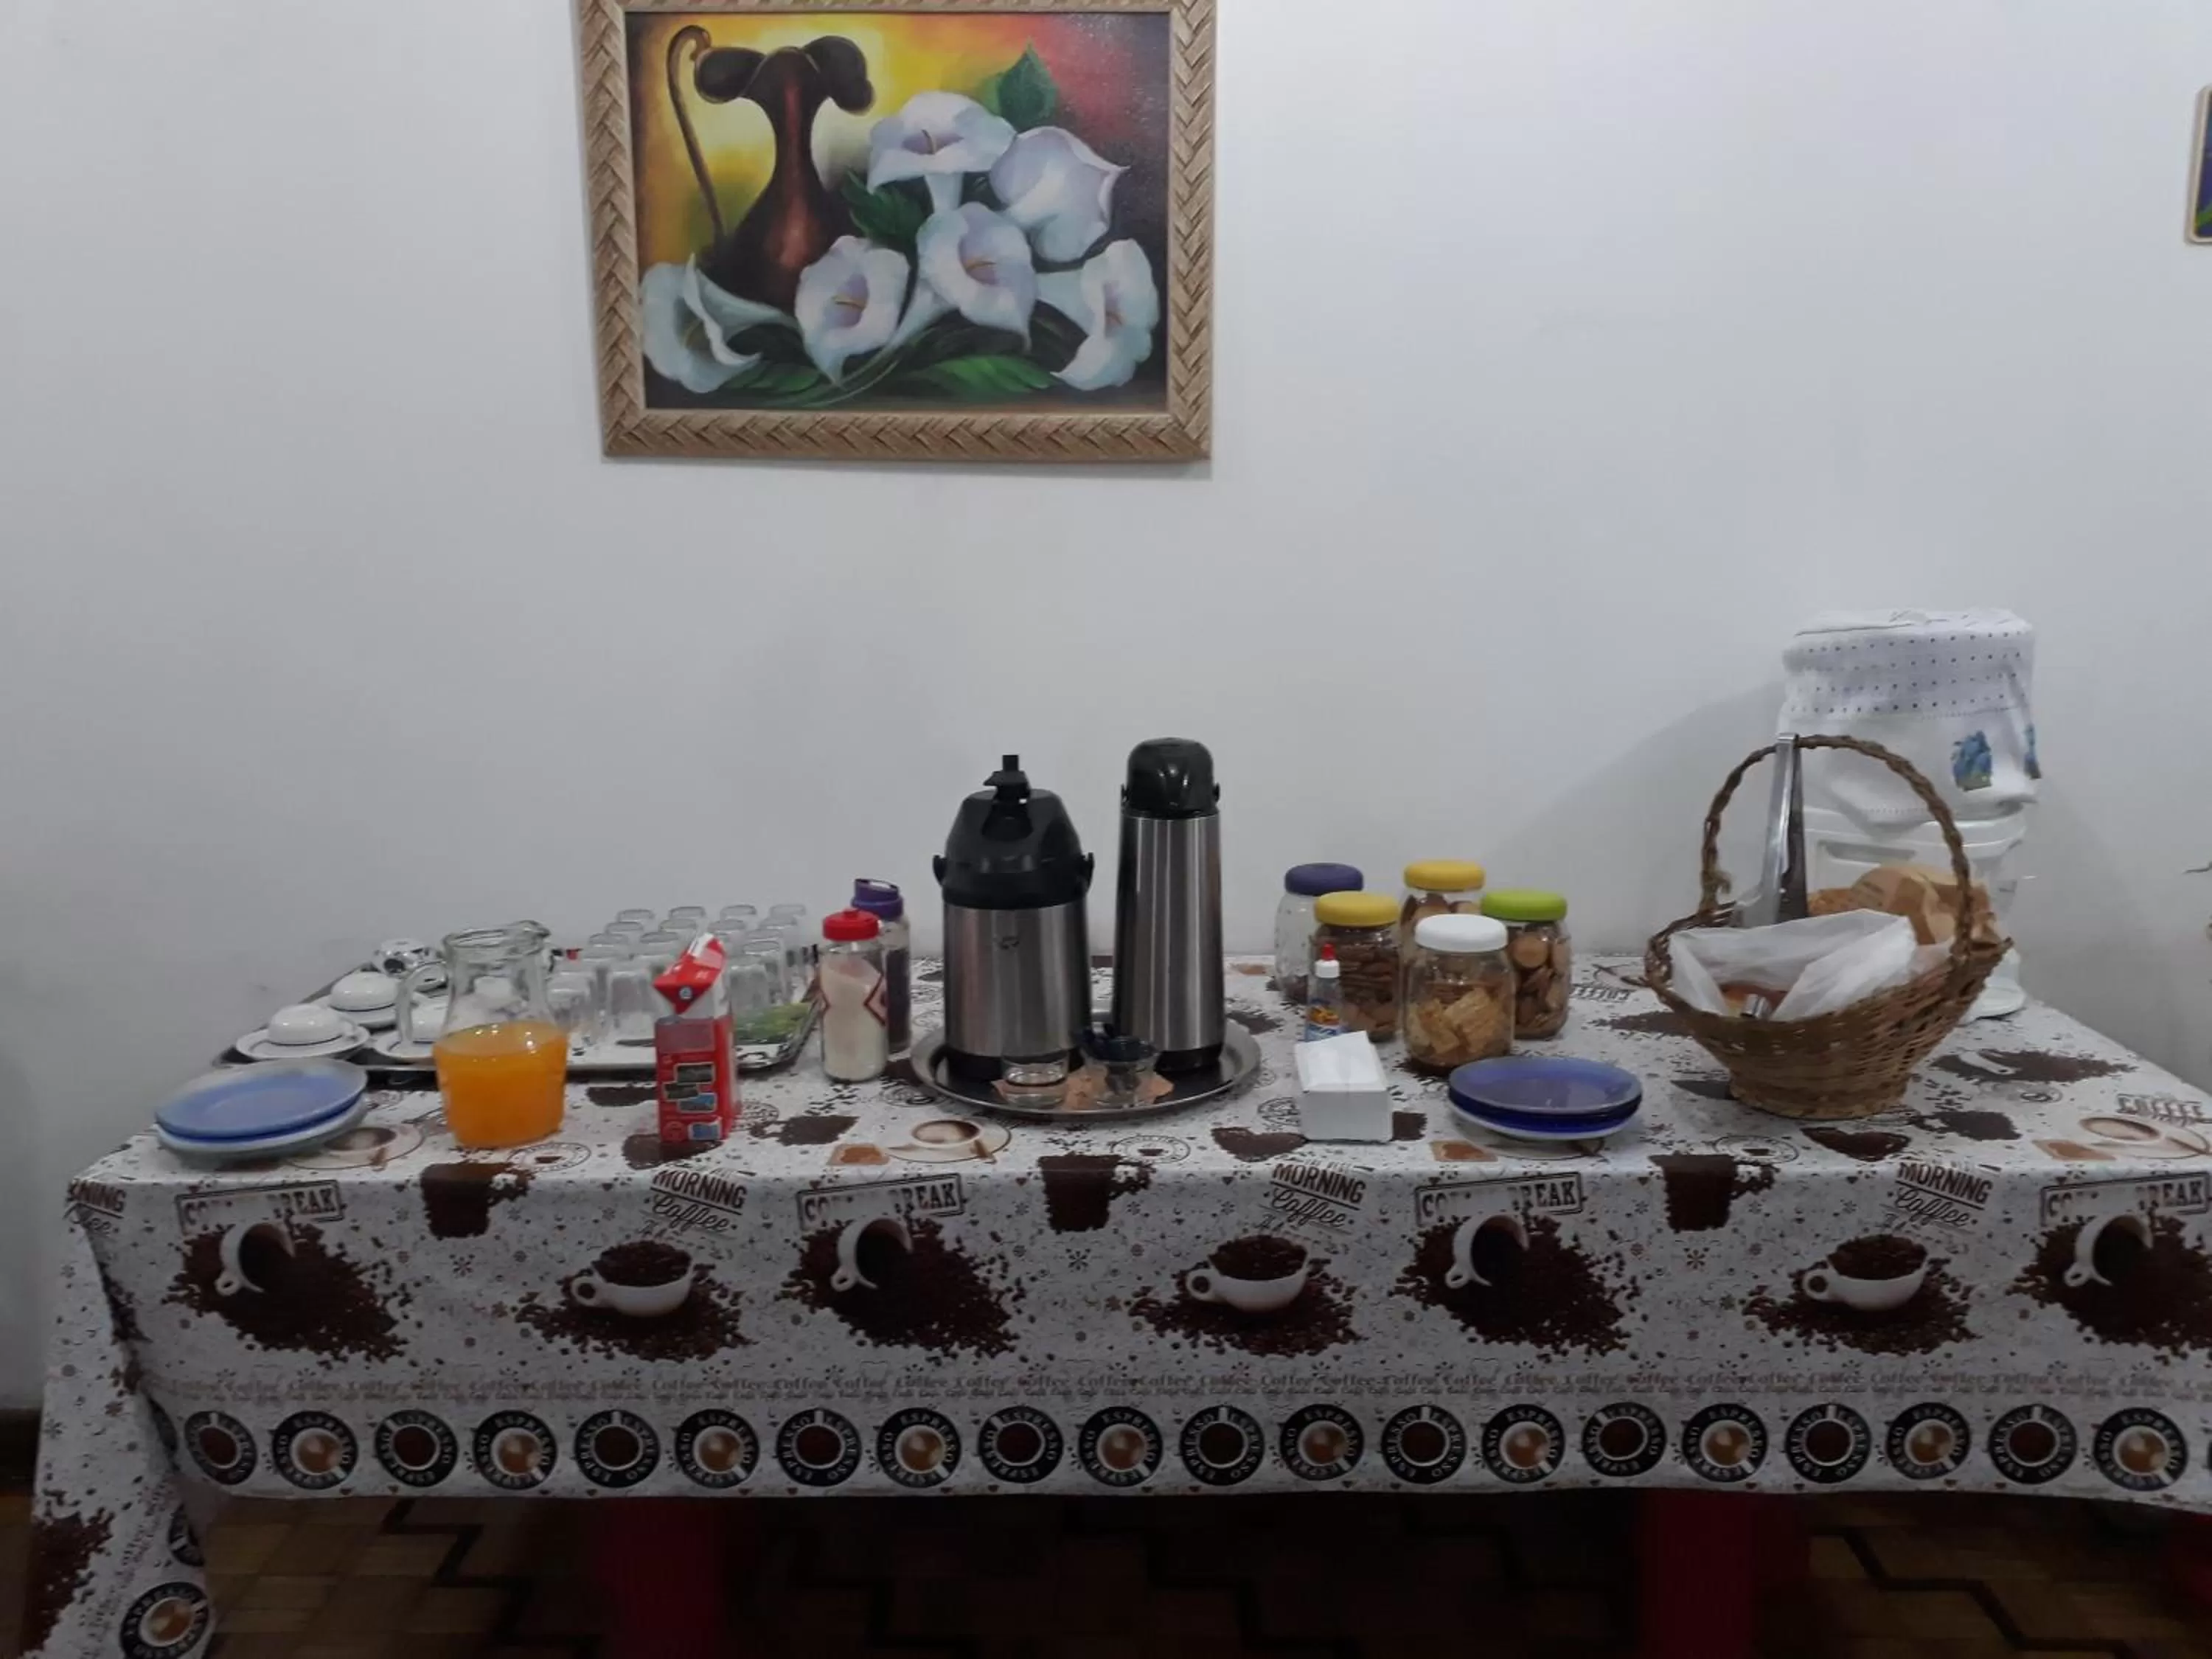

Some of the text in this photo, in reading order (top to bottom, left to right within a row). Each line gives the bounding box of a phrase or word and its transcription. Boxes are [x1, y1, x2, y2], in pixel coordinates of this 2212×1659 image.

[653, 1169, 748, 1209] MORNING
[1273, 1163, 1367, 1204] MORNING
[1896, 1162, 1993, 1204] MORNING
[653, 1194, 729, 1231] Coffee
[1273, 1188, 1346, 1226] Coffee
[1896, 1188, 1968, 1225] Coffee
